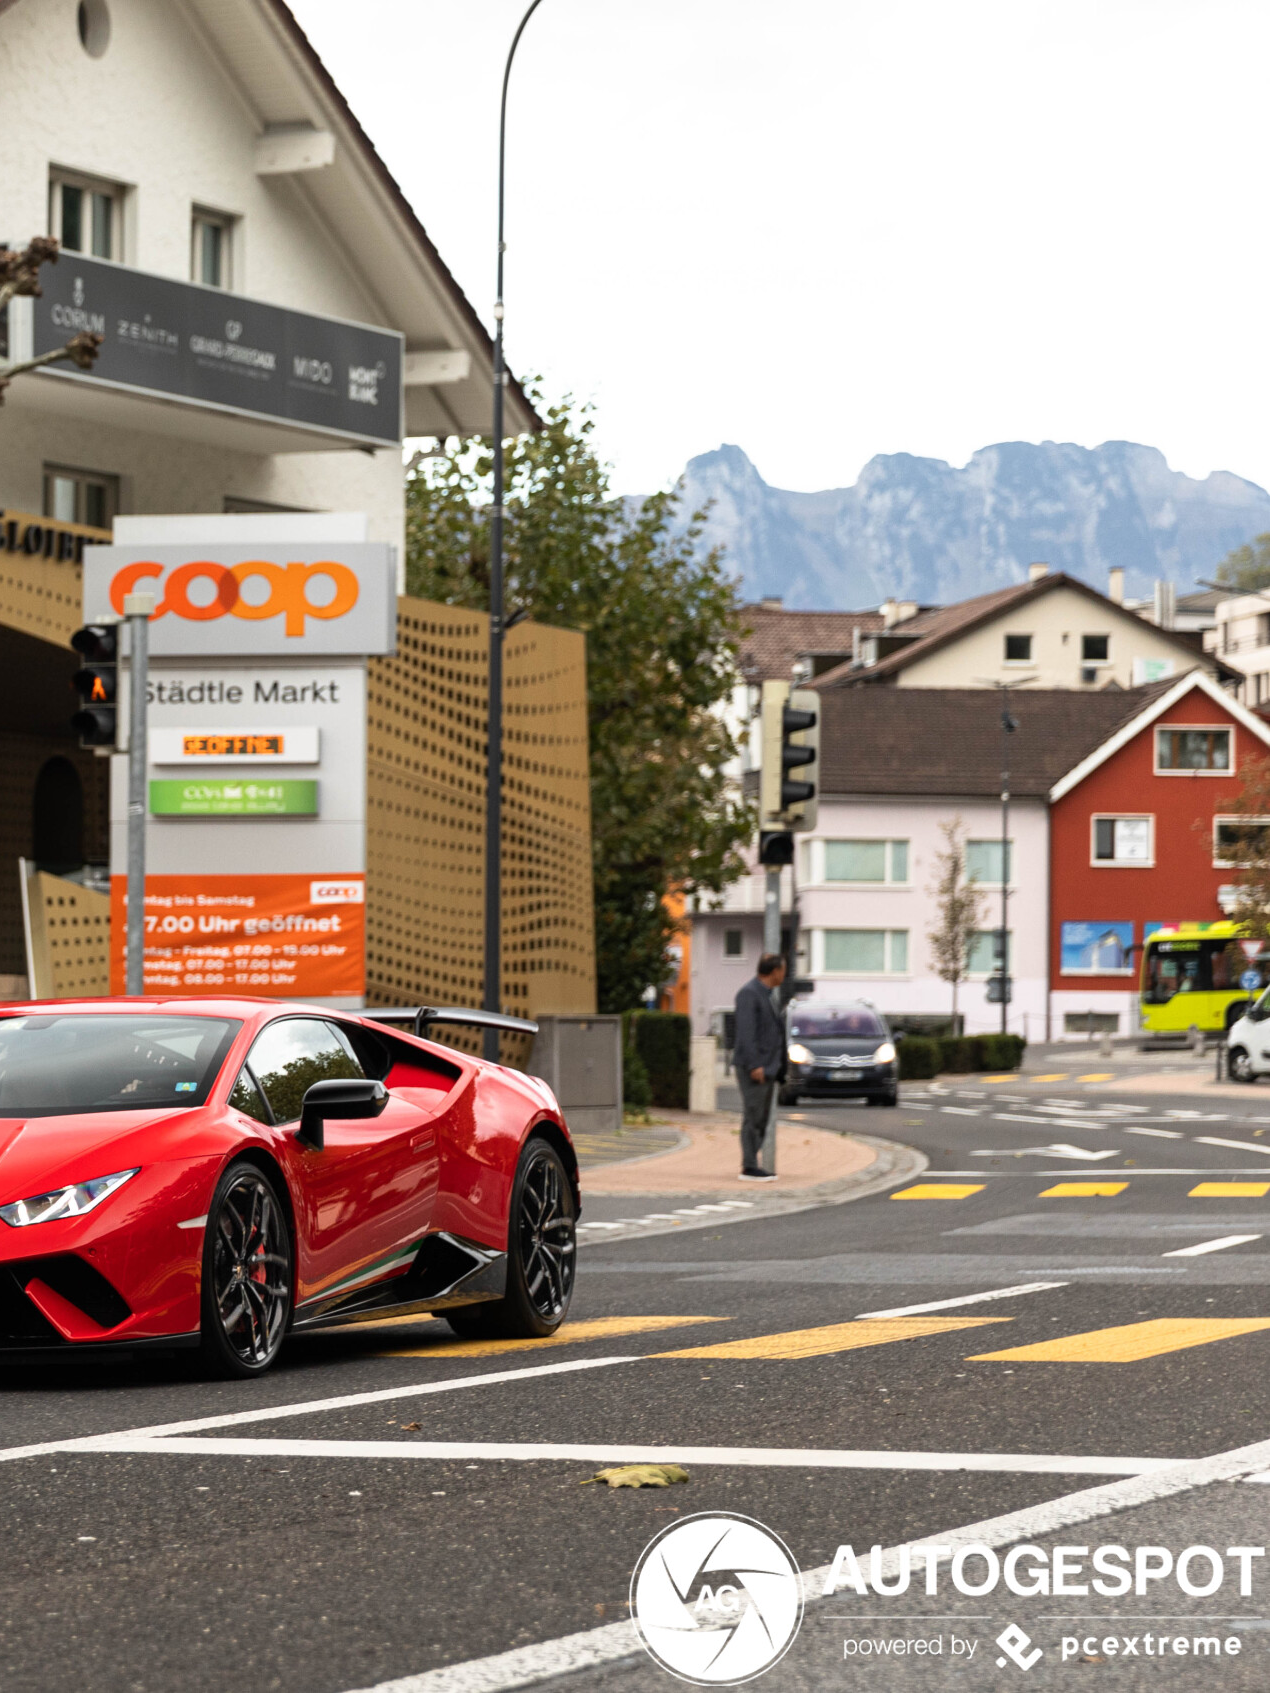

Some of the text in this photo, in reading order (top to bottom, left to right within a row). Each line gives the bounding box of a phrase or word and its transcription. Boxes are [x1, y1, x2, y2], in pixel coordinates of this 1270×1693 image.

[117, 319, 179, 346] ZENITH
[109, 560, 360, 638] coop
[144, 680, 340, 704] Städtle Markt
[175, 894, 195, 906] bis
[196, 894, 256, 908] Samstag
[199, 916, 240, 932] Uhr
[244, 914, 342, 935] geöffnet
[321, 945, 347, 956] Uhr
[272, 959, 297, 970] Uhr
[271, 974, 297, 985] Uhr
